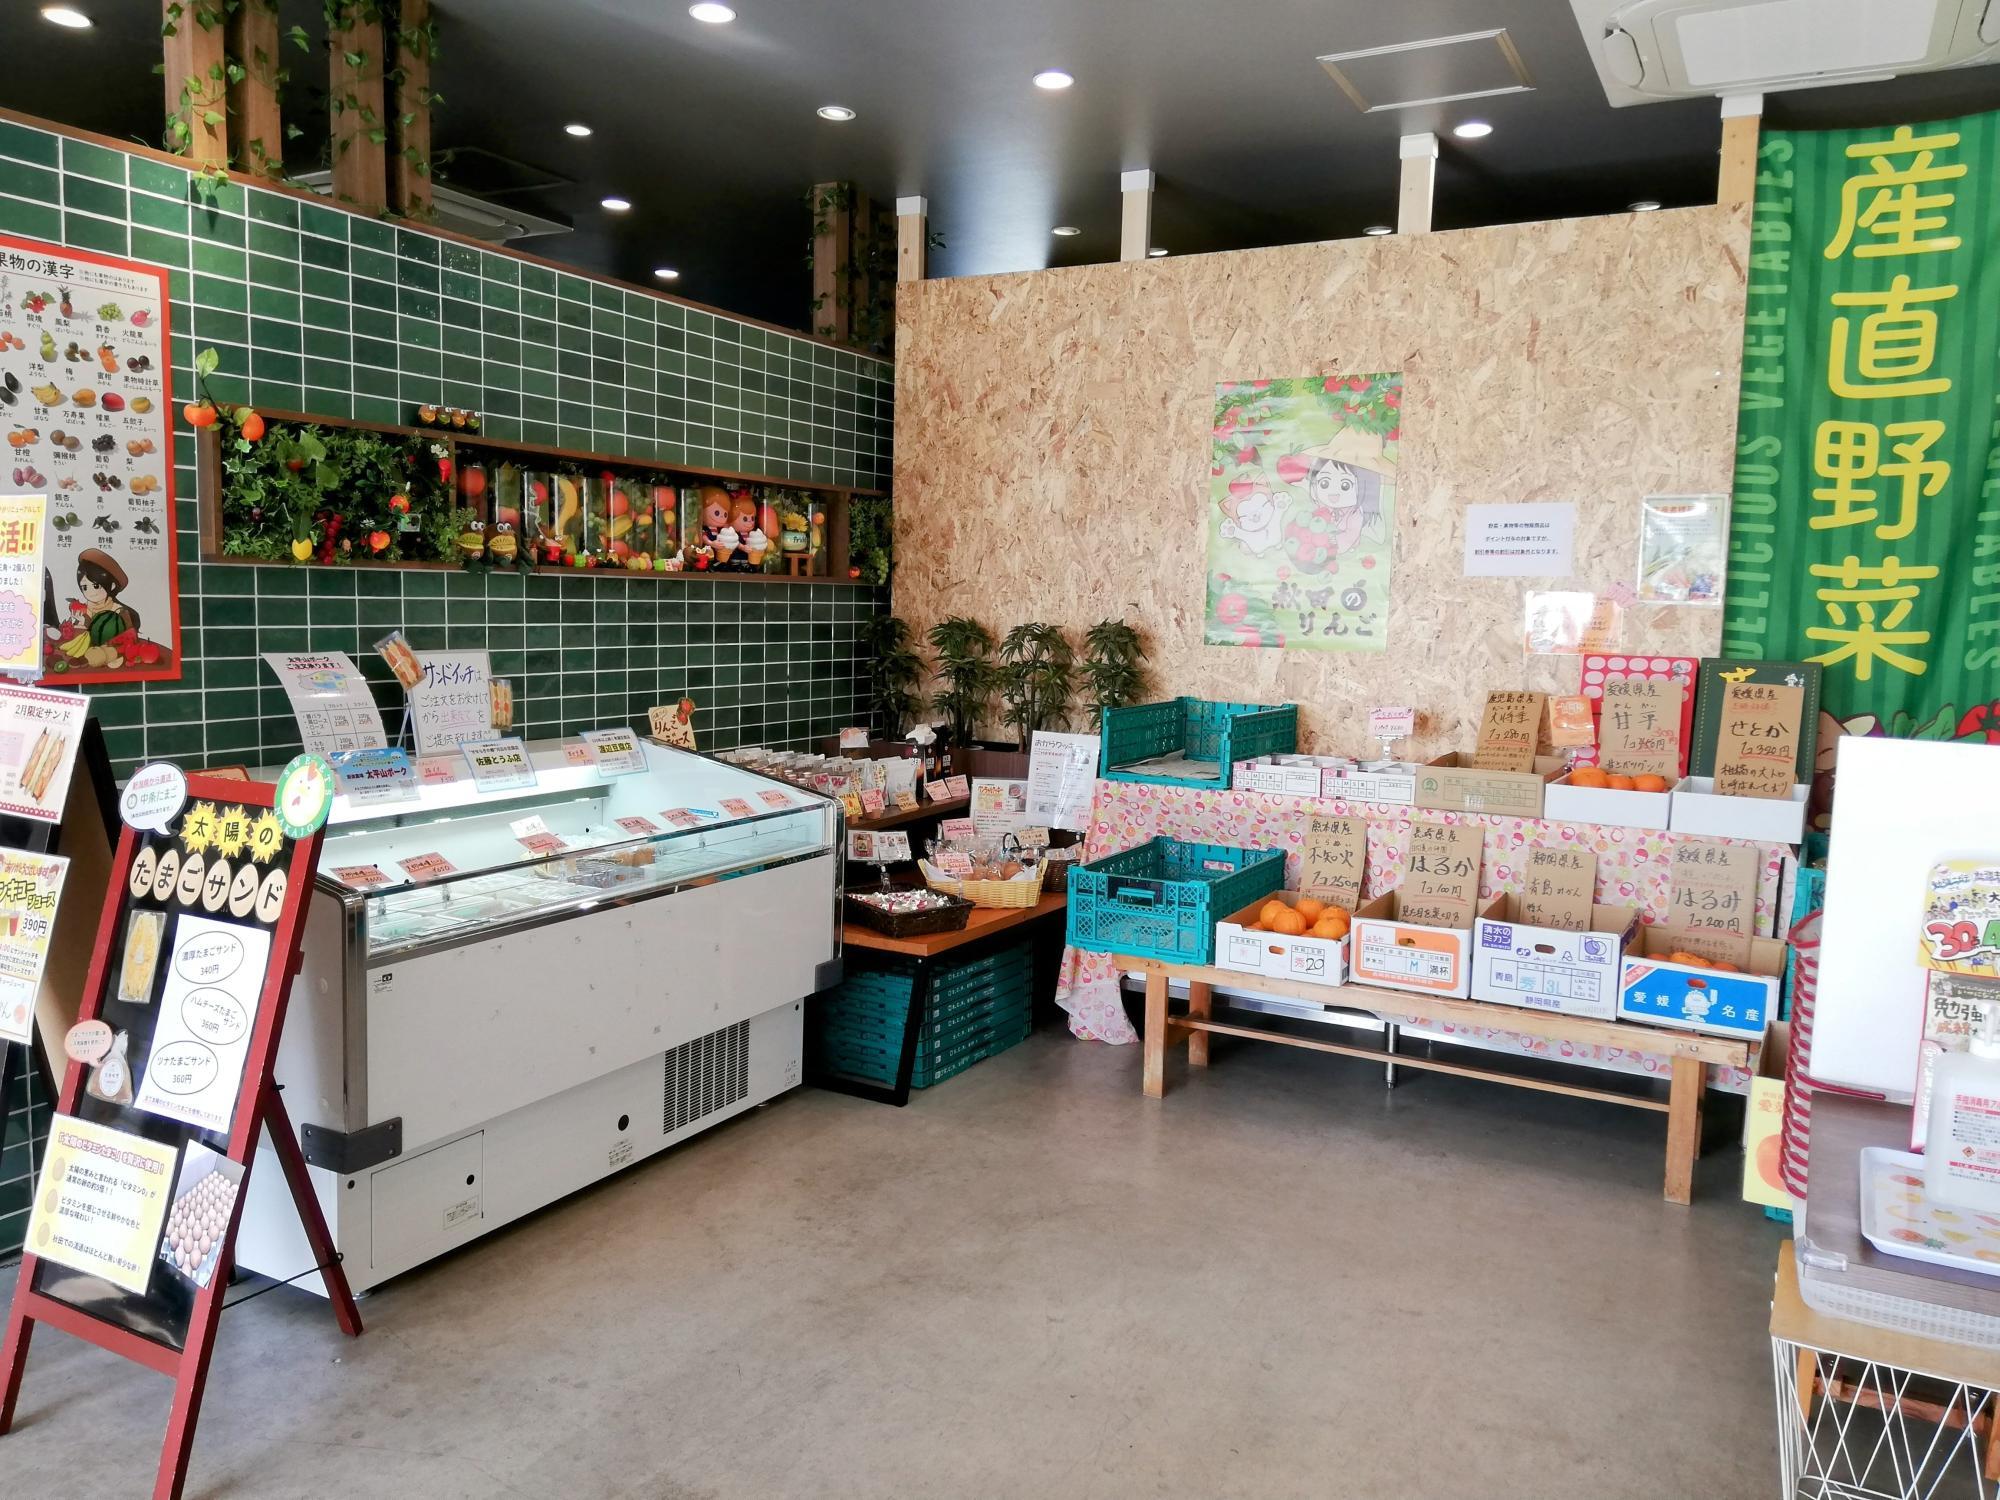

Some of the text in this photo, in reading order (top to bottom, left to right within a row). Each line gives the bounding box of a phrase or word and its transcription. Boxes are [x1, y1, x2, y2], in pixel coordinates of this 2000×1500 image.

[1740, 139, 1794, 409] VEGETABLES
[1802, 125, 1968, 681] 産直野菜
[1299, 611, 1377, 636] りんご
[1607, 681, 1661, 697] 愛媛県産
[1731, 686, 1778, 700] 愛媛県産
[1488, 692, 1537, 704] 鹿児島県産
[15, 704, 71, 722] 2月限定サンド
[1611, 711, 1658, 730] 甘平
[1729, 720, 1790, 738] せとか
[476, 753, 522, 766] 佐藤とうふ店
[284, 756, 333, 796] SWEETS
[365, 767, 407, 779] 太平山ポーク
[192, 816, 274, 846] 太陽の
[1312, 819, 1353, 835] 熊本県産
[1309, 847, 1354, 868] 不知火
[1410, 856, 1475, 877] はるか
[133, 859, 283, 909] たまごサンド
[1676, 887, 1742, 912] はるみ
[22, 918, 48, 935] 390円
[1483, 924, 1512, 937] 清水の
[1483, 933, 1512, 945] ミカン
[200, 964, 220, 976] 340円
[1305, 957, 1325, 972] 20
[1410, 960, 1419, 972] M
[1495, 971, 1513, 982] 青島
[1546, 978, 1562, 994] 3L
[1525, 995, 1560, 1009] 静岡県産
[1633, 991, 1760, 1022] 愛媛 名産
[1933, 996, 1983, 1023] 勉強
[156, 1056, 212, 1067] ツナたまごサンド
[172, 1073, 193, 1085] 360円
